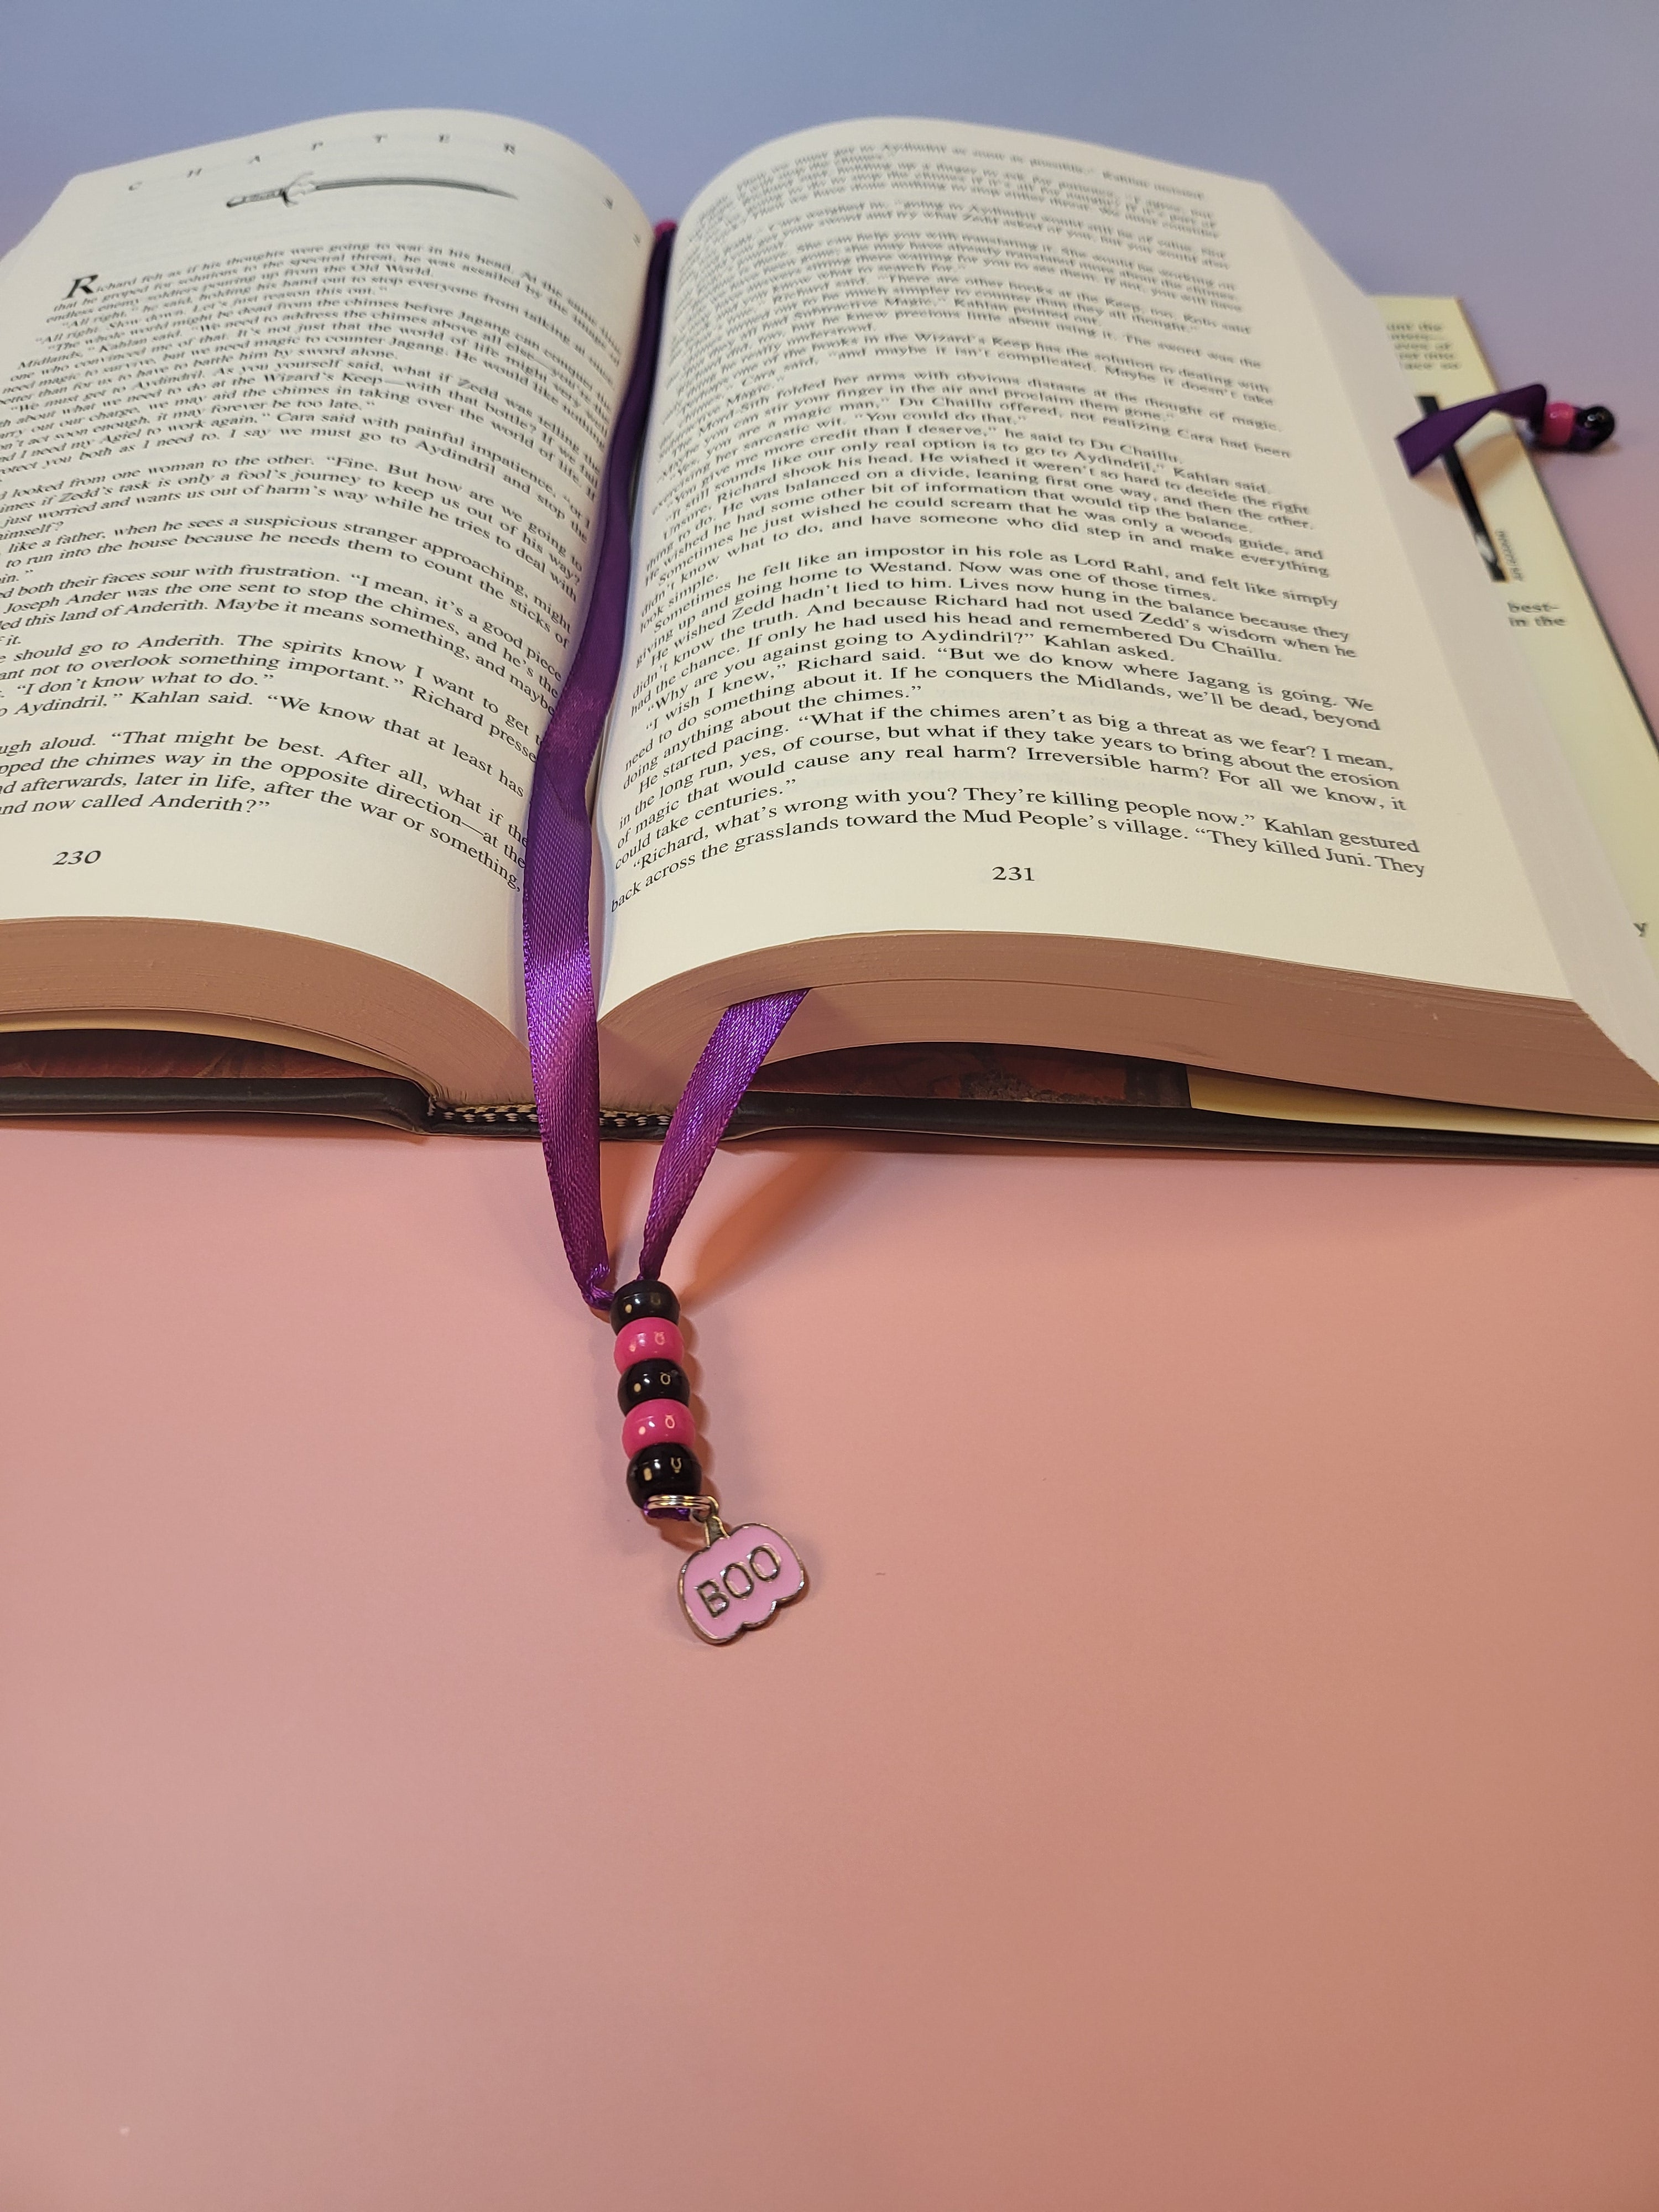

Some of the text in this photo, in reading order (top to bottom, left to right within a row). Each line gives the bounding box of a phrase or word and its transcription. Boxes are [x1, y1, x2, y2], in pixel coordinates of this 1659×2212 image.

[12, 481, 65, 498] looked
[69, 475, 106, 488] from
[112, 469, 141, 481] one
[148, 462, 204, 474] woman
[212, 460, 228, 468] to
[235, 456, 260, 466] the
[267, 455, 314, 465] other.
[388, 463, 418, 479] But
[425, 473, 462, 492] how
[468, 491, 494, 507] are
[838, 457, 862, 468] his
[920, 452, 943, 463] He
[950, 454, 1009, 466] wished
[1016, 457, 1026, 467] it
[1100, 471, 1119, 479] so
[1123, 472, 1160, 487] hard
[1165, 481, 1181, 491] to
[1185, 484, 1236, 500] decide
[1243, 495, 1266, 505] the
[1271, 503, 1307, 514] right
[654, 545, 1338, 634] Sometimes he felt like an impostor in his role as Lord Rahl, and felt like simply
[620, 724, 1400, 830] in the long run, yes, of course, but what if they take years to bring about the erosion
[639, 705, 1393, 795] He started pacing. “What if the chimes aren’t as big a threat as we fear? I mean,
[20, 773, 127, 792] afterwards,
[134, 772, 184, 785] later
[187, 773, 208, 787] in
[215, 774, 255, 793] life,
[264, 781, 315, 800] after
[321, 790, 352, 807] the
[360, 801, 398, 822] war
[403, 817, 425, 832] or
[430, 827, 520, 892] something,
[31, 800, 76, 812] now
[81, 794, 144, 808] called
[148, 794, 270, 813] Anderith?”
[39, 734, 96, 750] aloud.
[111, 731, 167, 744] “That
[174, 731, 236, 748] might
[244, 733, 268, 748] be
[278, 737, 324, 757] best.
[335, 749, 391, 774] After
[398, 769, 427, 790] all,
[439, 784, 482, 814] what
[488, 808, 504, 827] if
[508, 824, 528, 860] the
[50, 756, 80, 769] the
[86, 752, 156, 766] chimes
[165, 754, 206, 768] way
[211, 752, 232, 766] in
[241, 755, 273, 770] the
[280, 763, 369, 789] opposite
[504, 844, 526, 879] the
[615, 779, 796, 870] could take centuries.”
[714, 806, 777, 833] what’s
[784, 796, 848, 814] wrong
[854, 789, 901, 804] with
[906, 787, 957, 805] you?
[963, 787, 1047, 805] They’re
[1051, 790, 1119, 812] killing
[1124, 801, 1192, 819] people
[1196, 811, 1255, 827] now.”
[1262, 817, 1334, 841] Kahlan
[1339, 833, 1420, 853] gestured
[53, 850, 101, 865] 230
[611, 809, 1425, 913] back across the grasslands toward the Mud People’s village. “They killed Juni. They
[992, 867, 1035, 881] 231
[695, 1544, 781, 1619] BOO
